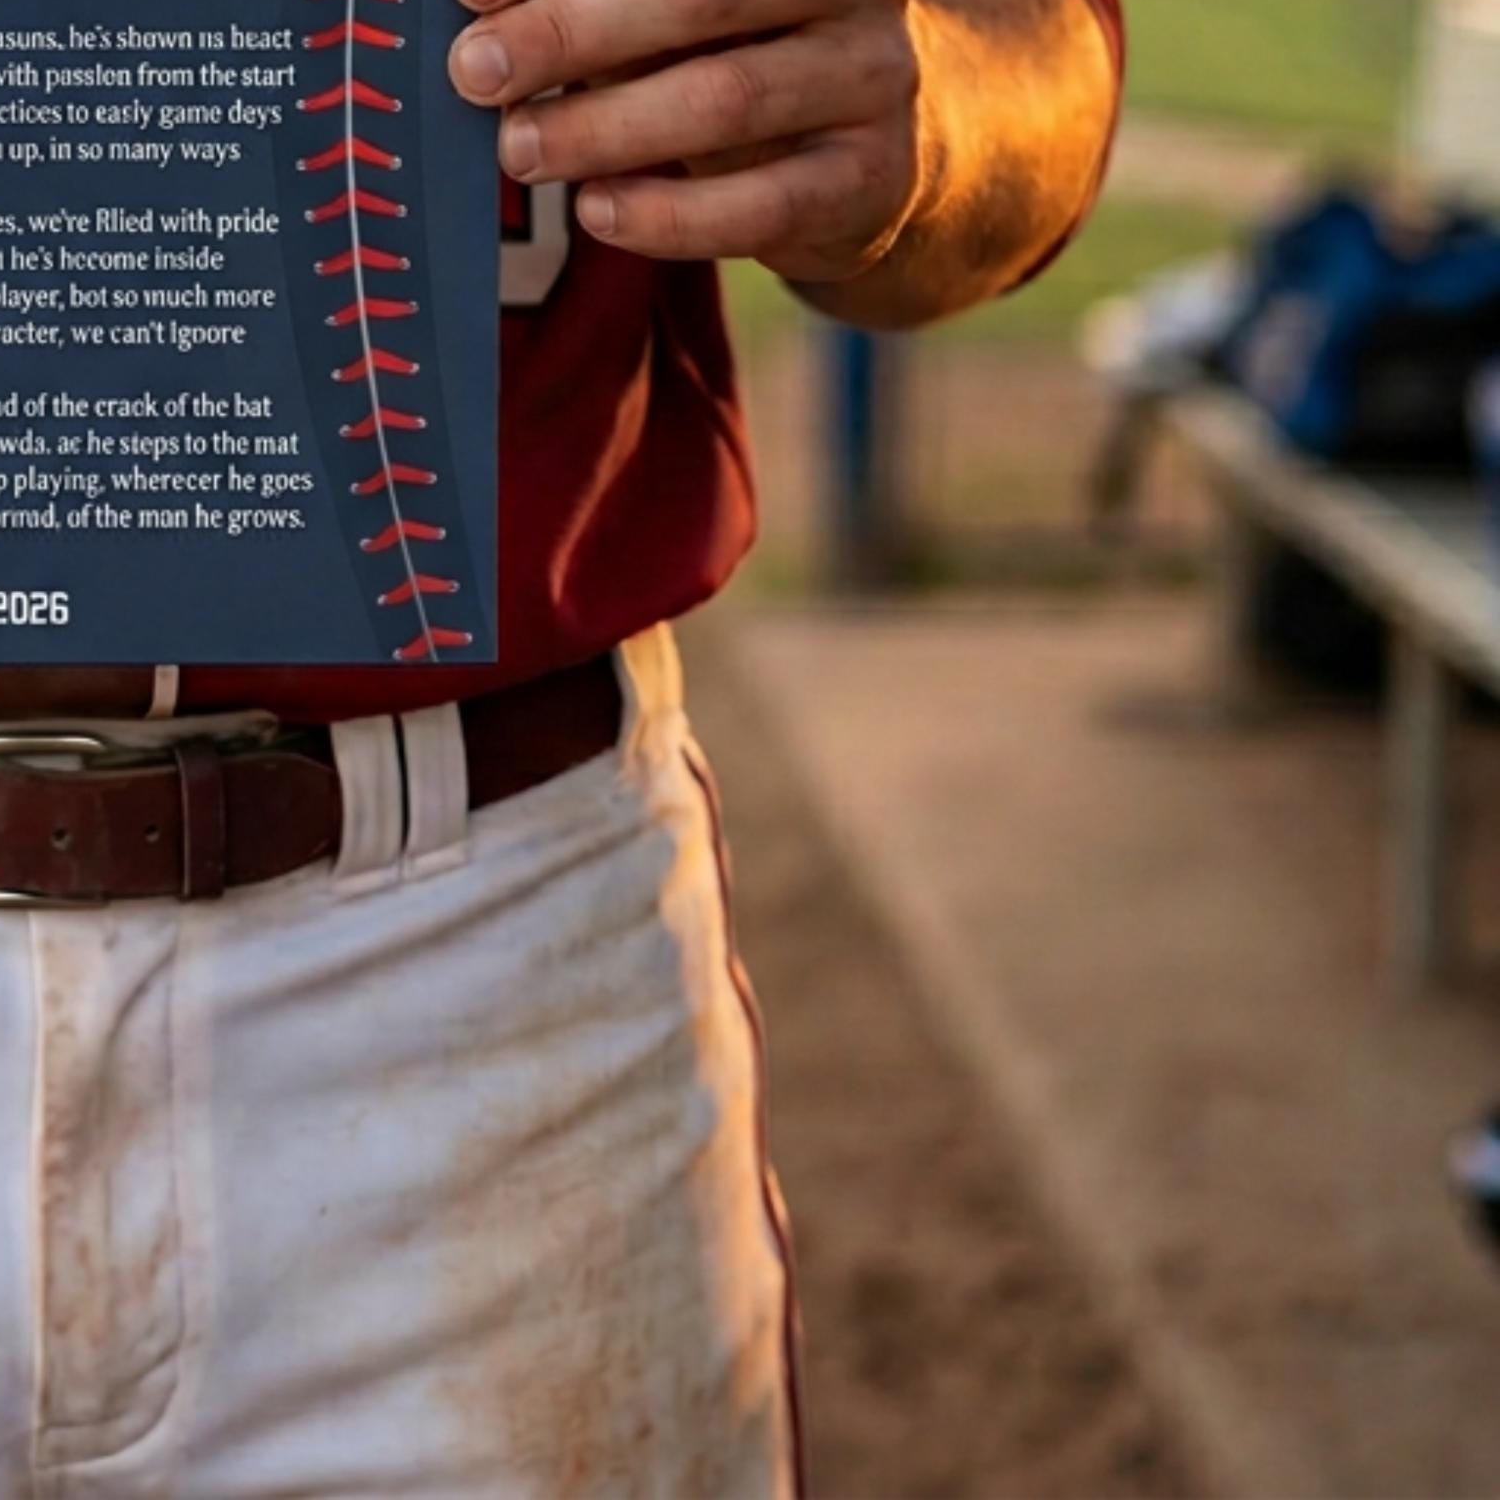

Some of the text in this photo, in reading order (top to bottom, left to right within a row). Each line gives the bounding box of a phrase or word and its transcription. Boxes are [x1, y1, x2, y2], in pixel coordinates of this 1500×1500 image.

[136, 61, 195, 87] from
[240, 64, 296, 87] start
[66, 103, 90, 124] to
[157, 104, 223, 130] game
[49, 136, 72, 161] in
[76, 142, 104, 161] so
[108, 142, 174, 168] many
[179, 142, 242, 168] ways
[159, 207, 213, 234] with
[10, 245, 54, 271] he's
[154, 245, 225, 271] inside
[111, 289, 139, 308] so
[214, 289, 277, 308] more
[69, 325, 105, 345] we
[109, 320, 166, 345] can't
[22, 392, 48, 417] of
[51, 391, 90, 418] the
[93, 391, 160, 418] crack
[163, 392, 191, 418] of
[233, 392, 273, 418] bat
[86, 429, 116, 455] he
[183, 432, 209, 455] to
[253, 432, 300, 455] mat
[227, 464, 257, 492] he
[66, 501, 93, 529] of
[95, 501, 133, 529] the
[194, 502, 224, 529] he
